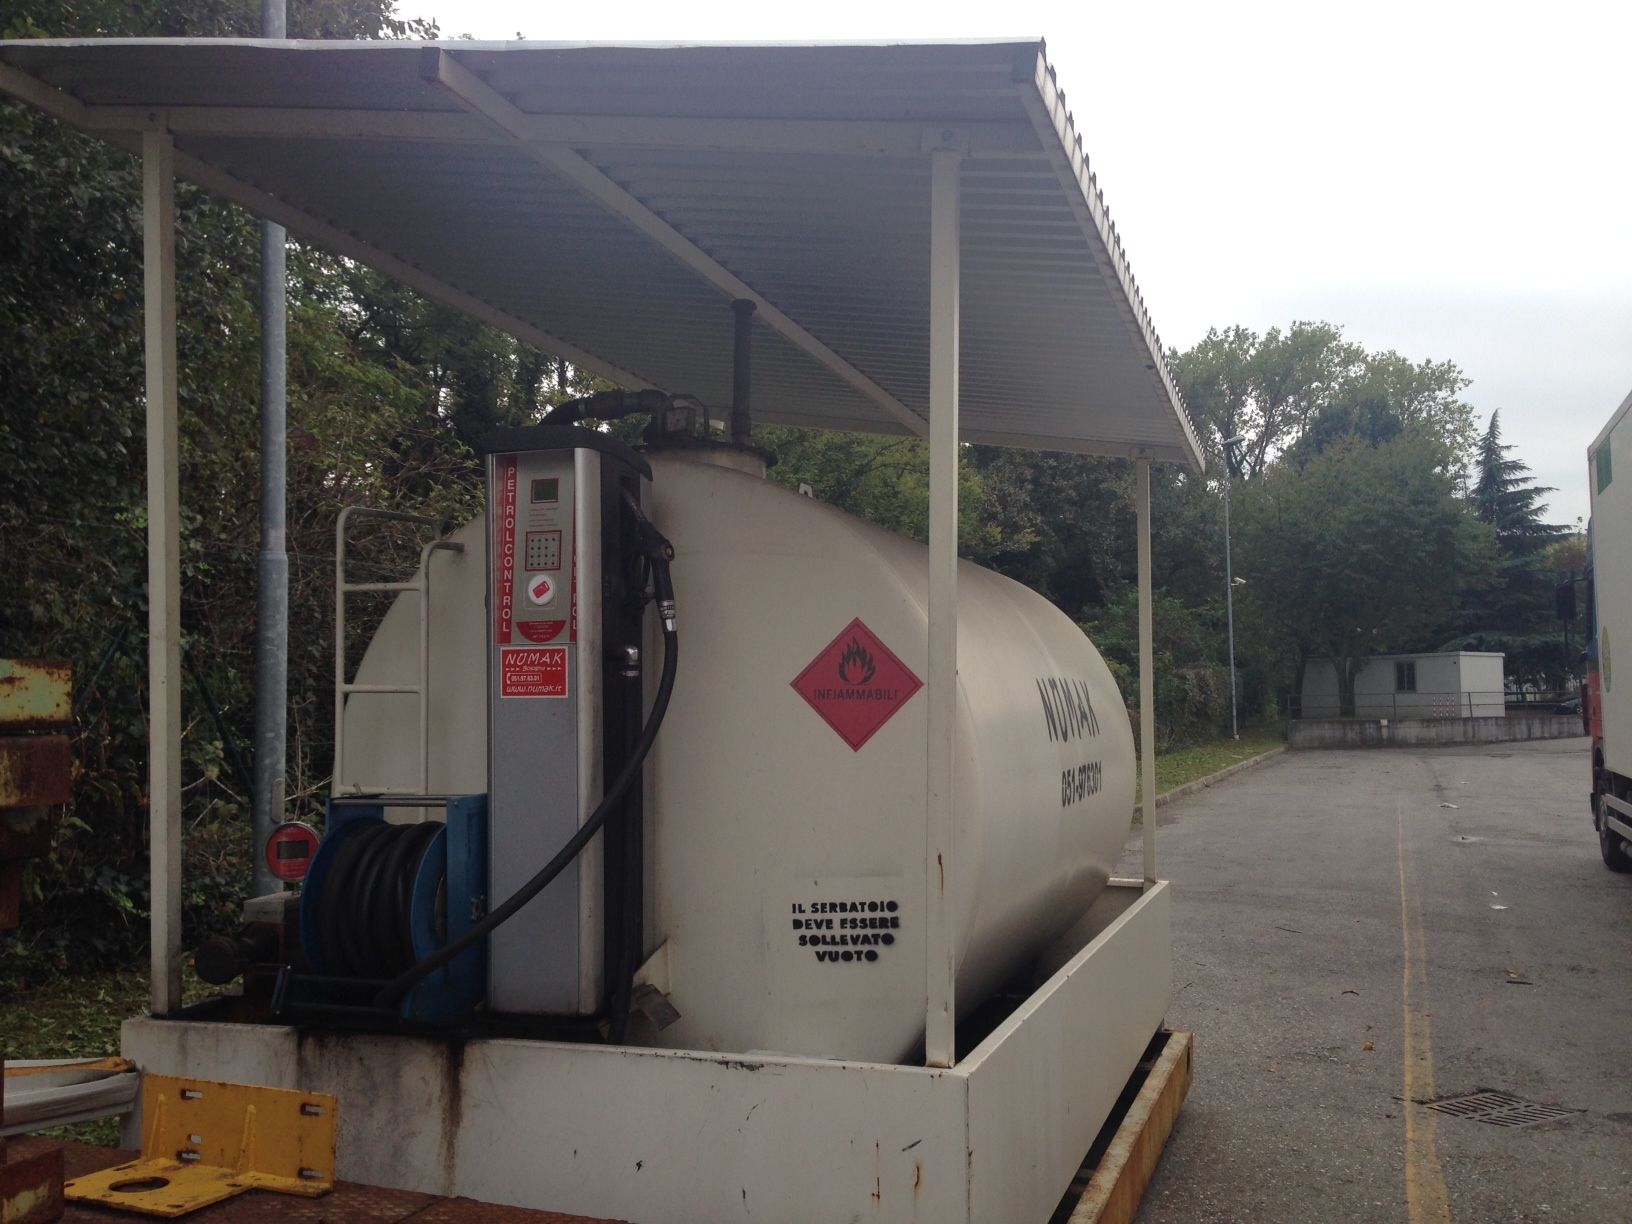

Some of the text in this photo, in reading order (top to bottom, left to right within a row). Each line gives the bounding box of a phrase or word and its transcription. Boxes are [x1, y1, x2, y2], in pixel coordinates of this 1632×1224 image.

[502, 467, 515, 632] PETROLCONTROL
[505, 652, 563, 665] NUMAK
[814, 688, 898, 700] INFIAMMABILI
[1062, 760, 1102, 808] 051-976301
[792, 900, 898, 914] IL SERBATOIO
[792, 916, 900, 930] DEVE ESSERE
[799, 933, 895, 946] SOLLEVATO
[815, 949, 878, 962] VUOTO
